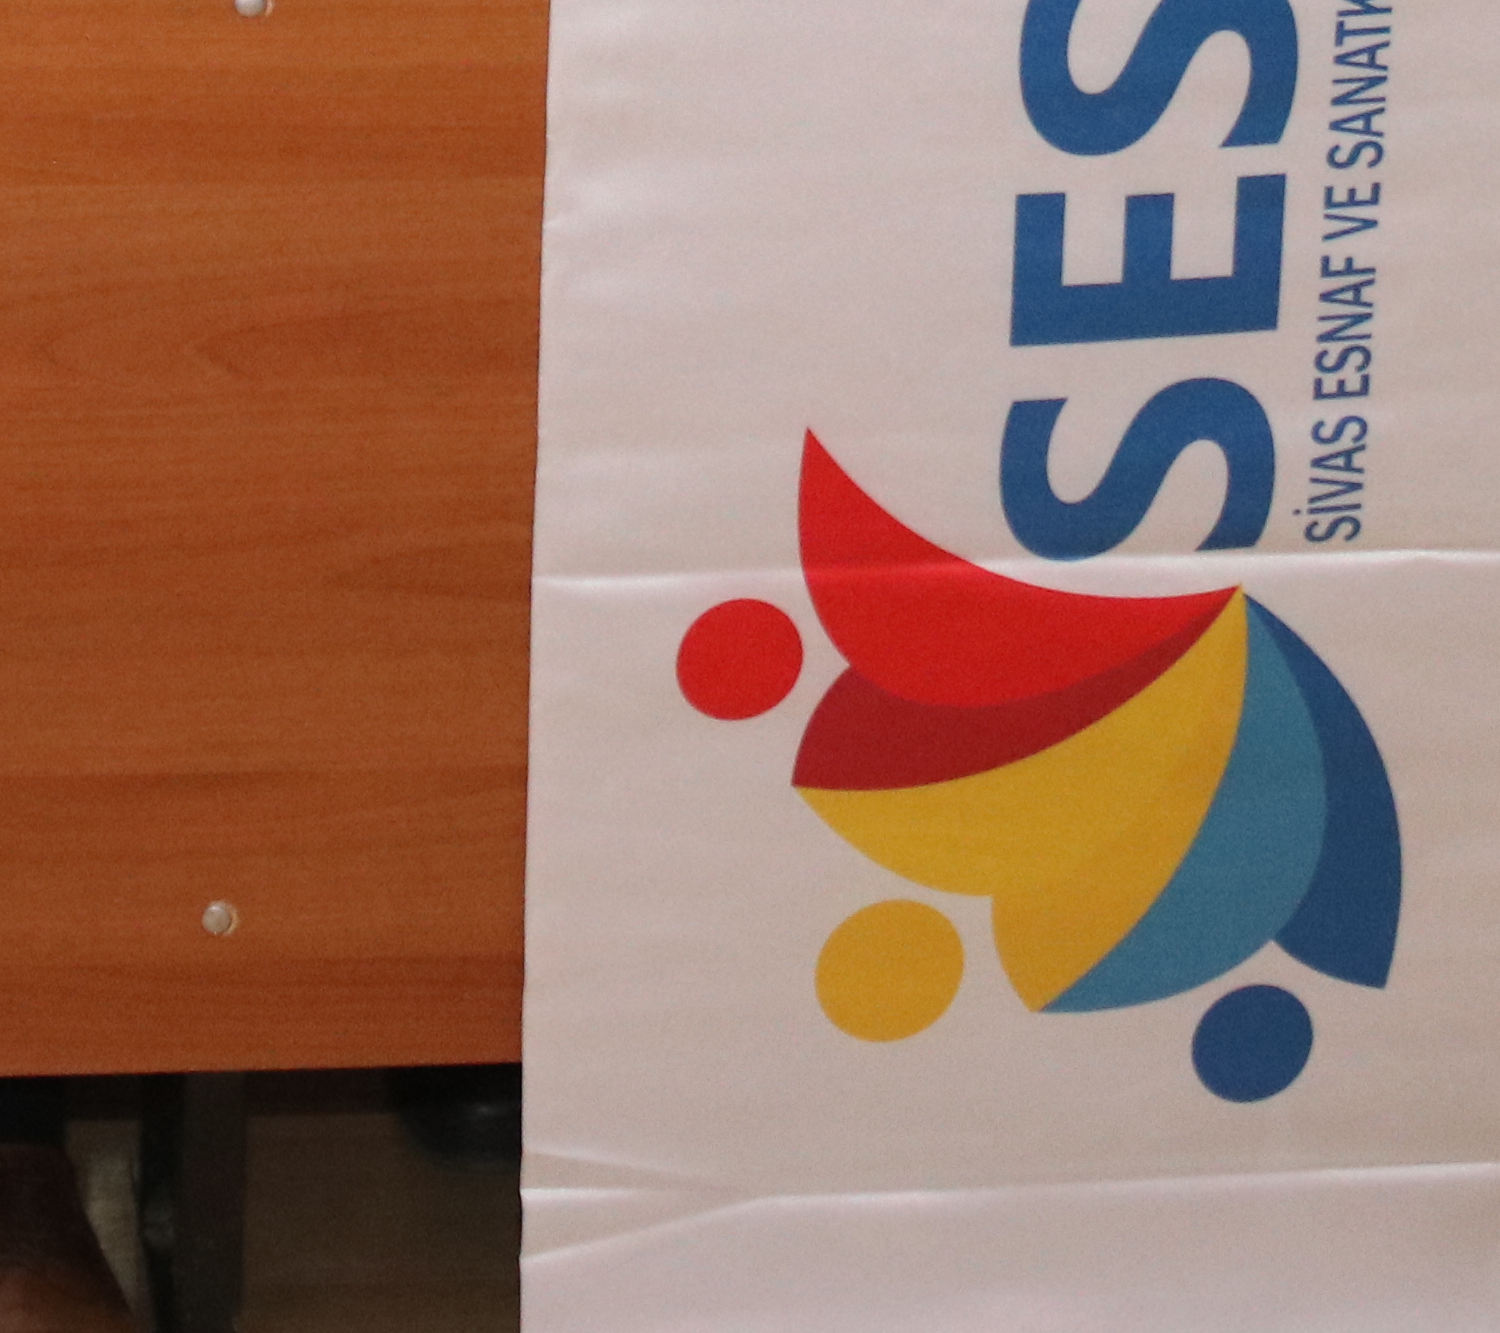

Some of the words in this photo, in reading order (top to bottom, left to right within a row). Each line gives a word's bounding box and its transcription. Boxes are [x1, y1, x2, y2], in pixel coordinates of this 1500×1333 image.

[1321, 181, 1382, 241] VE
[1313, 255, 1377, 400] ESNAF
[1293, 415, 1369, 543] SİVAS
